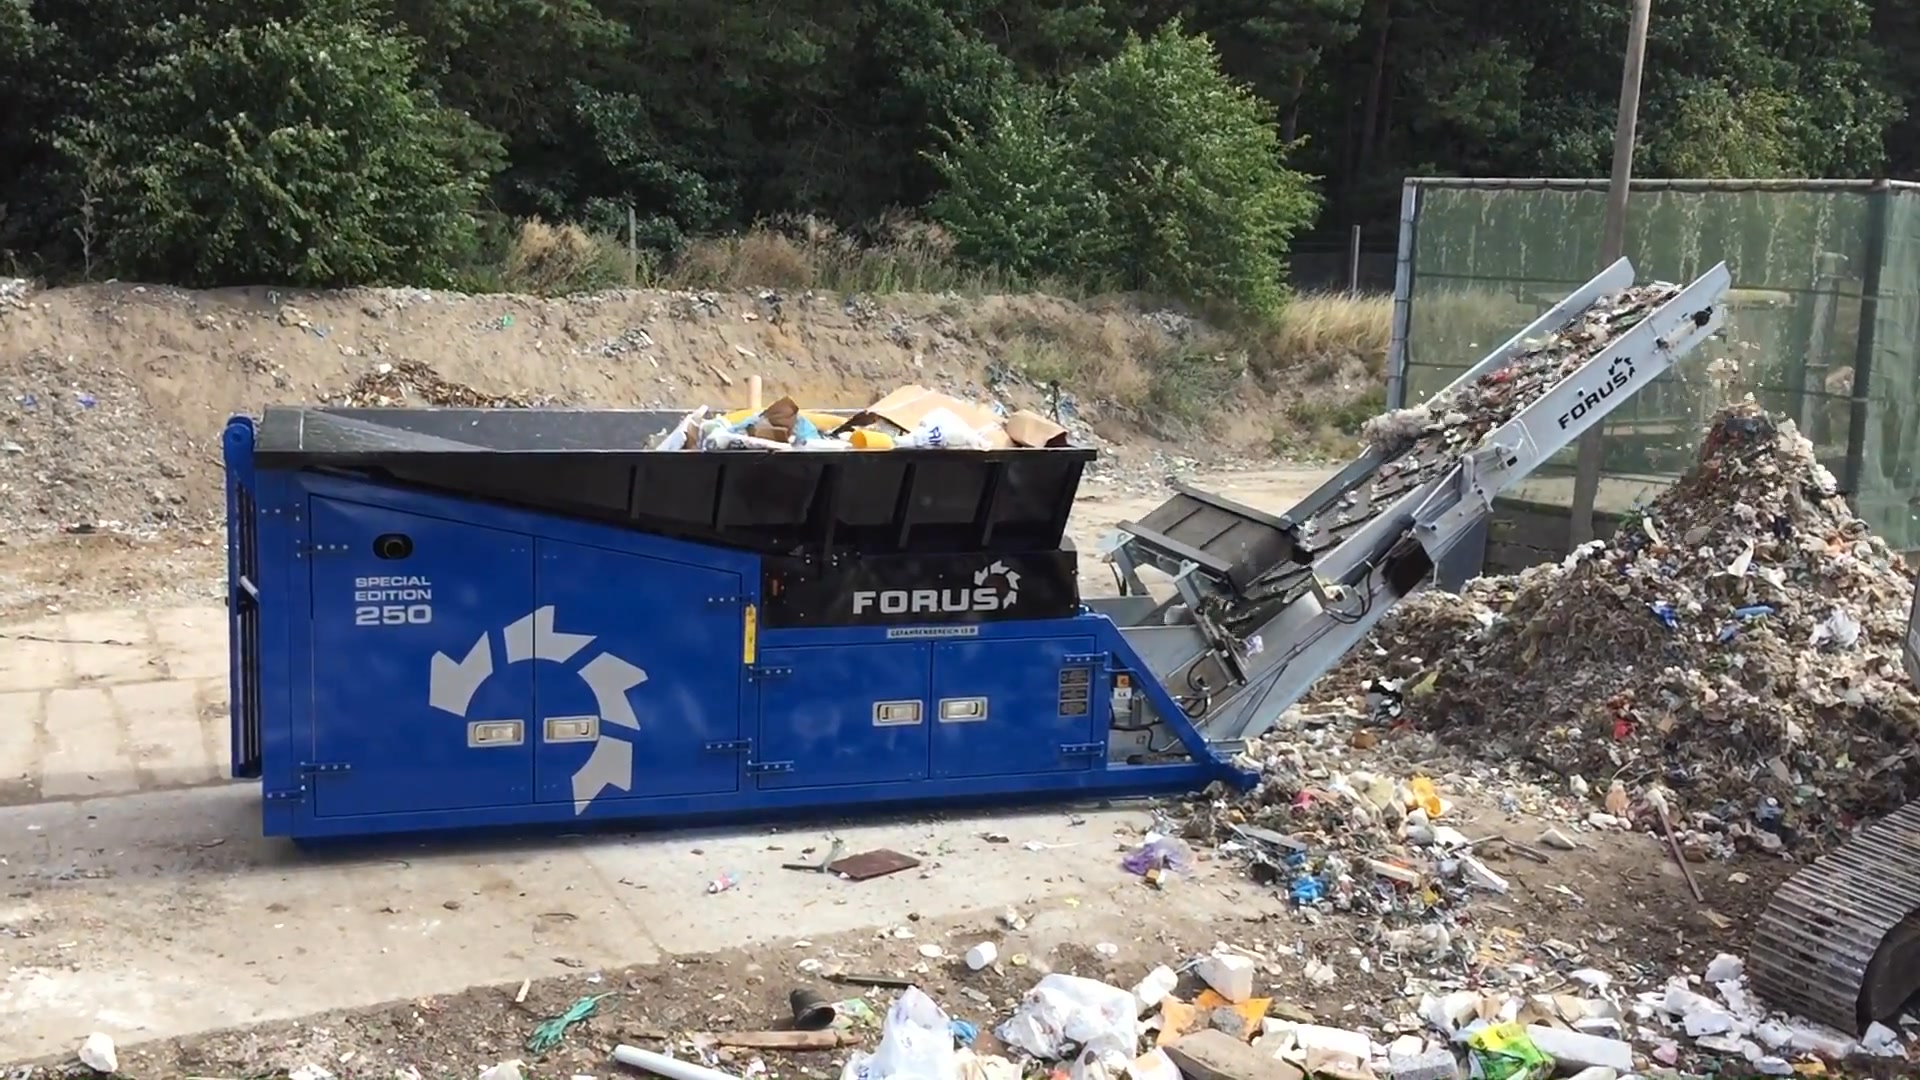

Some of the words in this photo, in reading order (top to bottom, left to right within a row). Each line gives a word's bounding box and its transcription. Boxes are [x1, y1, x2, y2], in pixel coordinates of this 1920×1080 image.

[1558, 371, 1628, 430] FORUS
[355, 576, 431, 588] SPECIAL
[355, 589, 432, 601] EDITION
[852, 587, 999, 614] FORUS
[355, 604, 432, 625] 250
